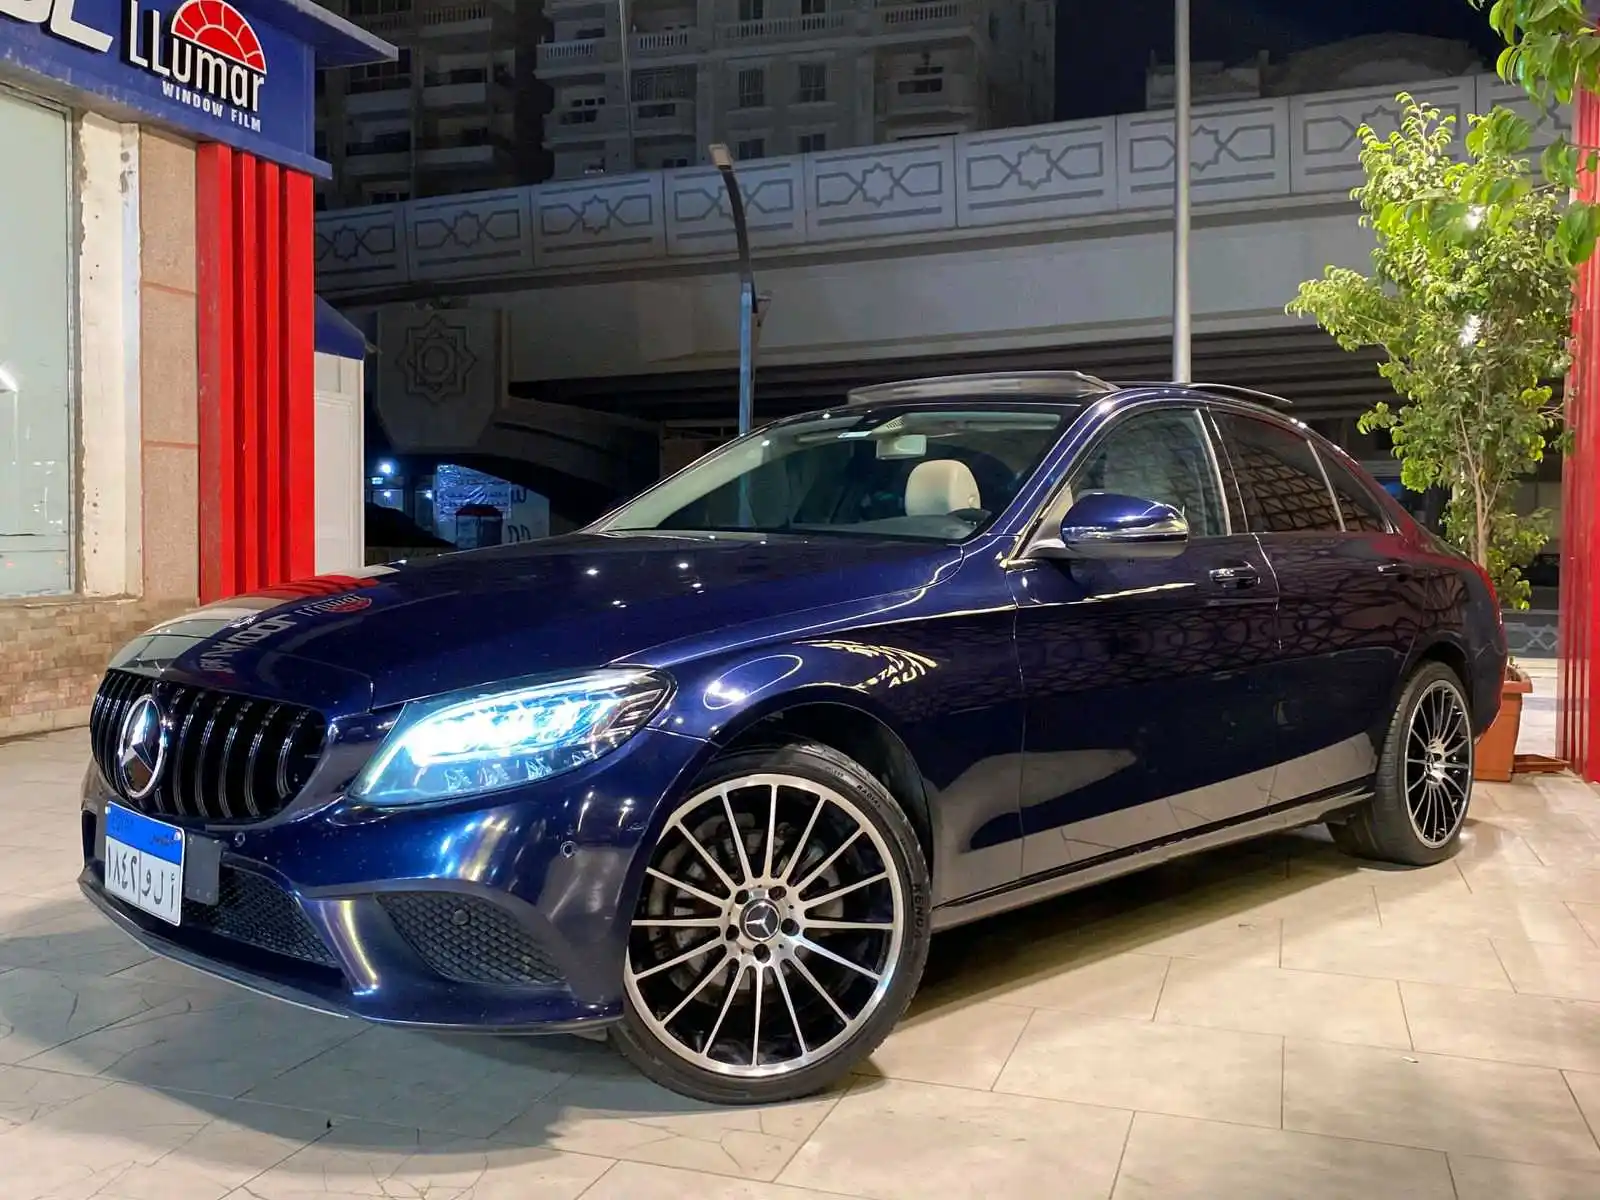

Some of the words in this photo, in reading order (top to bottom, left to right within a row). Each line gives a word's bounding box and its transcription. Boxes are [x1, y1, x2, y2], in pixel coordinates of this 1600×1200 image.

[130, 0, 265, 112] LLumar
[162, 81, 223, 117] WINDOW
[231, 108, 261, 132] FILM
